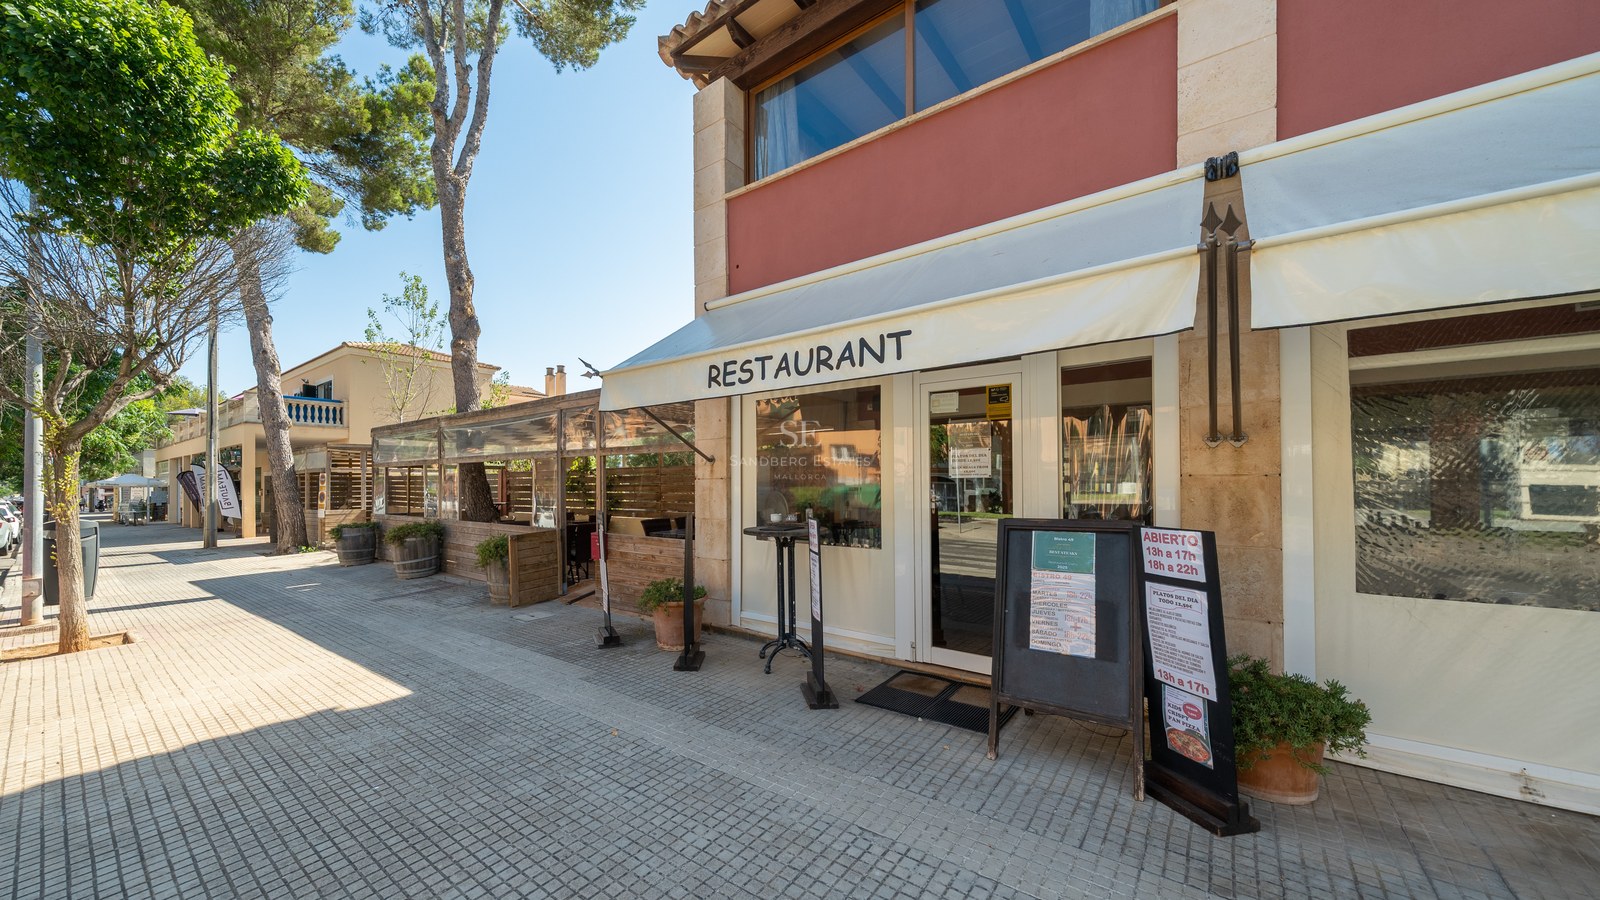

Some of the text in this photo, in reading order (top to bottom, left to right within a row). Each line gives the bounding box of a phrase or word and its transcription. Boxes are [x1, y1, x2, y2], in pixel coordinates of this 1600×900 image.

[707, 329, 912, 388] RESTAURANT
[1143, 531, 1199, 547] ABIERTO
[1146, 546, 1196, 561] 13h a 17h
[1148, 560, 1165, 571] 18h
[1176, 564, 1199, 575] 22h
[1153, 590, 1174, 599] PLATOS
[1031, 619, 1059, 627] VIERNES
[1031, 639, 1062, 647] DOMINGO
[1157, 668, 1175, 684] 13h
[1177, 678, 1184, 687] a
[1187, 680, 1210, 695] 17h
[1167, 702, 1182, 712] KIDS
[1167, 709, 1189, 721] CRISPY
[1168, 715, 1181, 724] PAN
[1181, 721, 1201, 733] PIZZA
